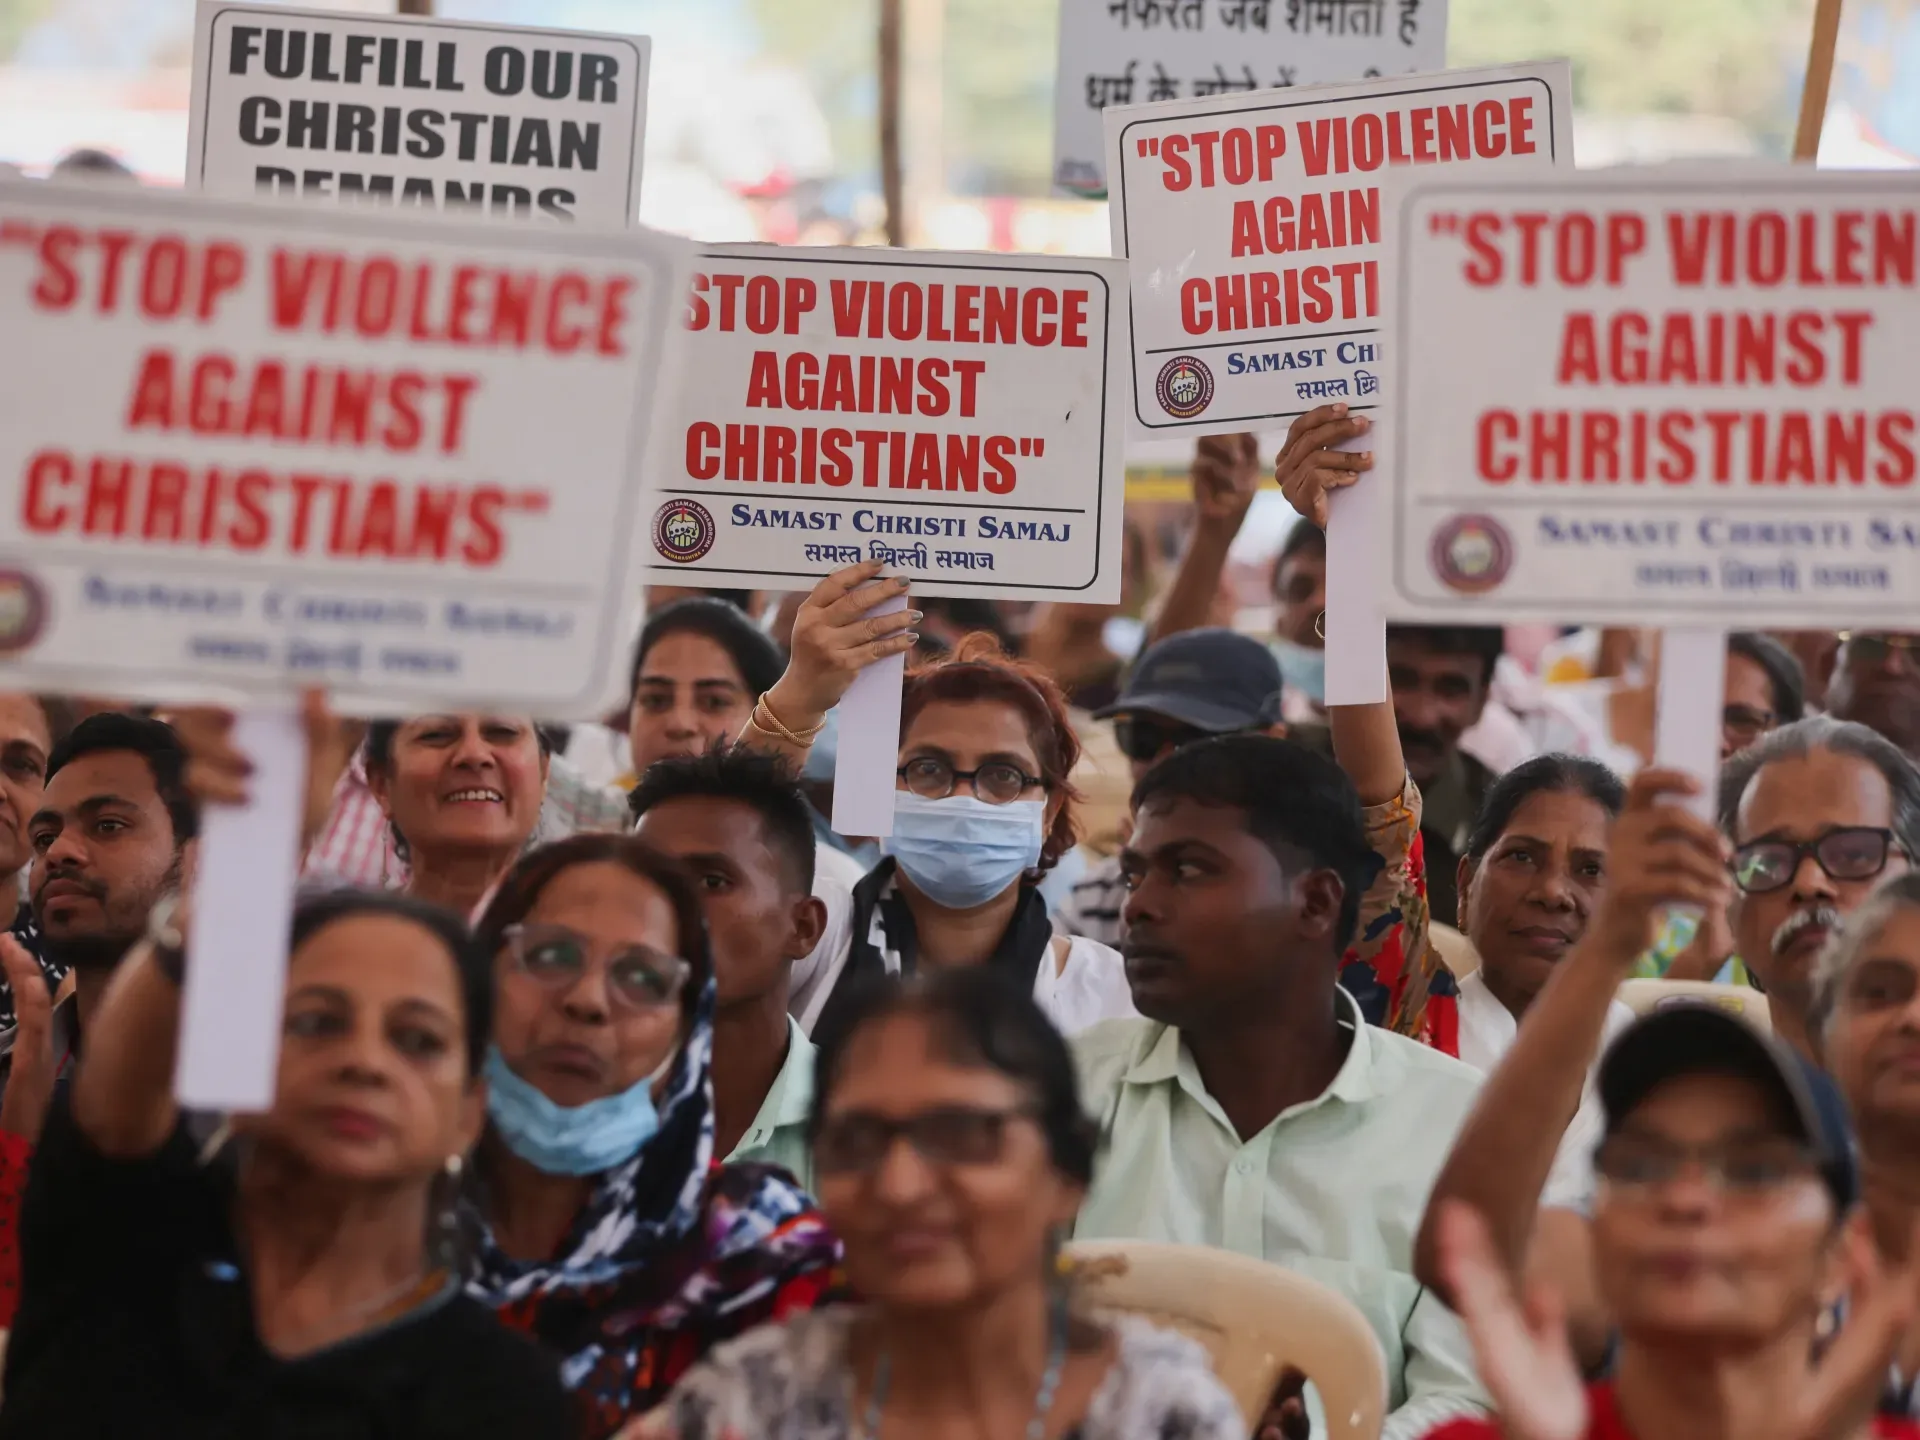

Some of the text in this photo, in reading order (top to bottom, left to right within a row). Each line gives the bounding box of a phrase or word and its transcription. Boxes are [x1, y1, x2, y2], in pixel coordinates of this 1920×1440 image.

[229, 26, 620, 104] FULFILL OUR
[238, 96, 601, 171] CHRISTIAN
[1136, 126, 1286, 191] "STOP
[1296, 97, 1536, 177] VIOLENCE
[0, 219, 637, 357] "STOP VIOLENCE
[1428, 210, 1916, 288] "STOP VIOLEN
[829, 279, 1088, 348] VIOLENCE
[1556, 310, 1873, 388] AGAINST
[746, 350, 986, 418] AGAINST
[1227, 341, 1382, 375] SAMAST CH
[128, 349, 477, 455] AGAINST
[685, 421, 1045, 494] CHRISTIANS"
[1475, 408, 1915, 486] CHRISTIANS
[20, 451, 552, 567] CHRISTIANS"
[731, 504, 1070, 542] SAMAST CHRISTI SAMAJ
[804, 543, 861, 563] समस्त
[936, 550, 995, 571] समाज
